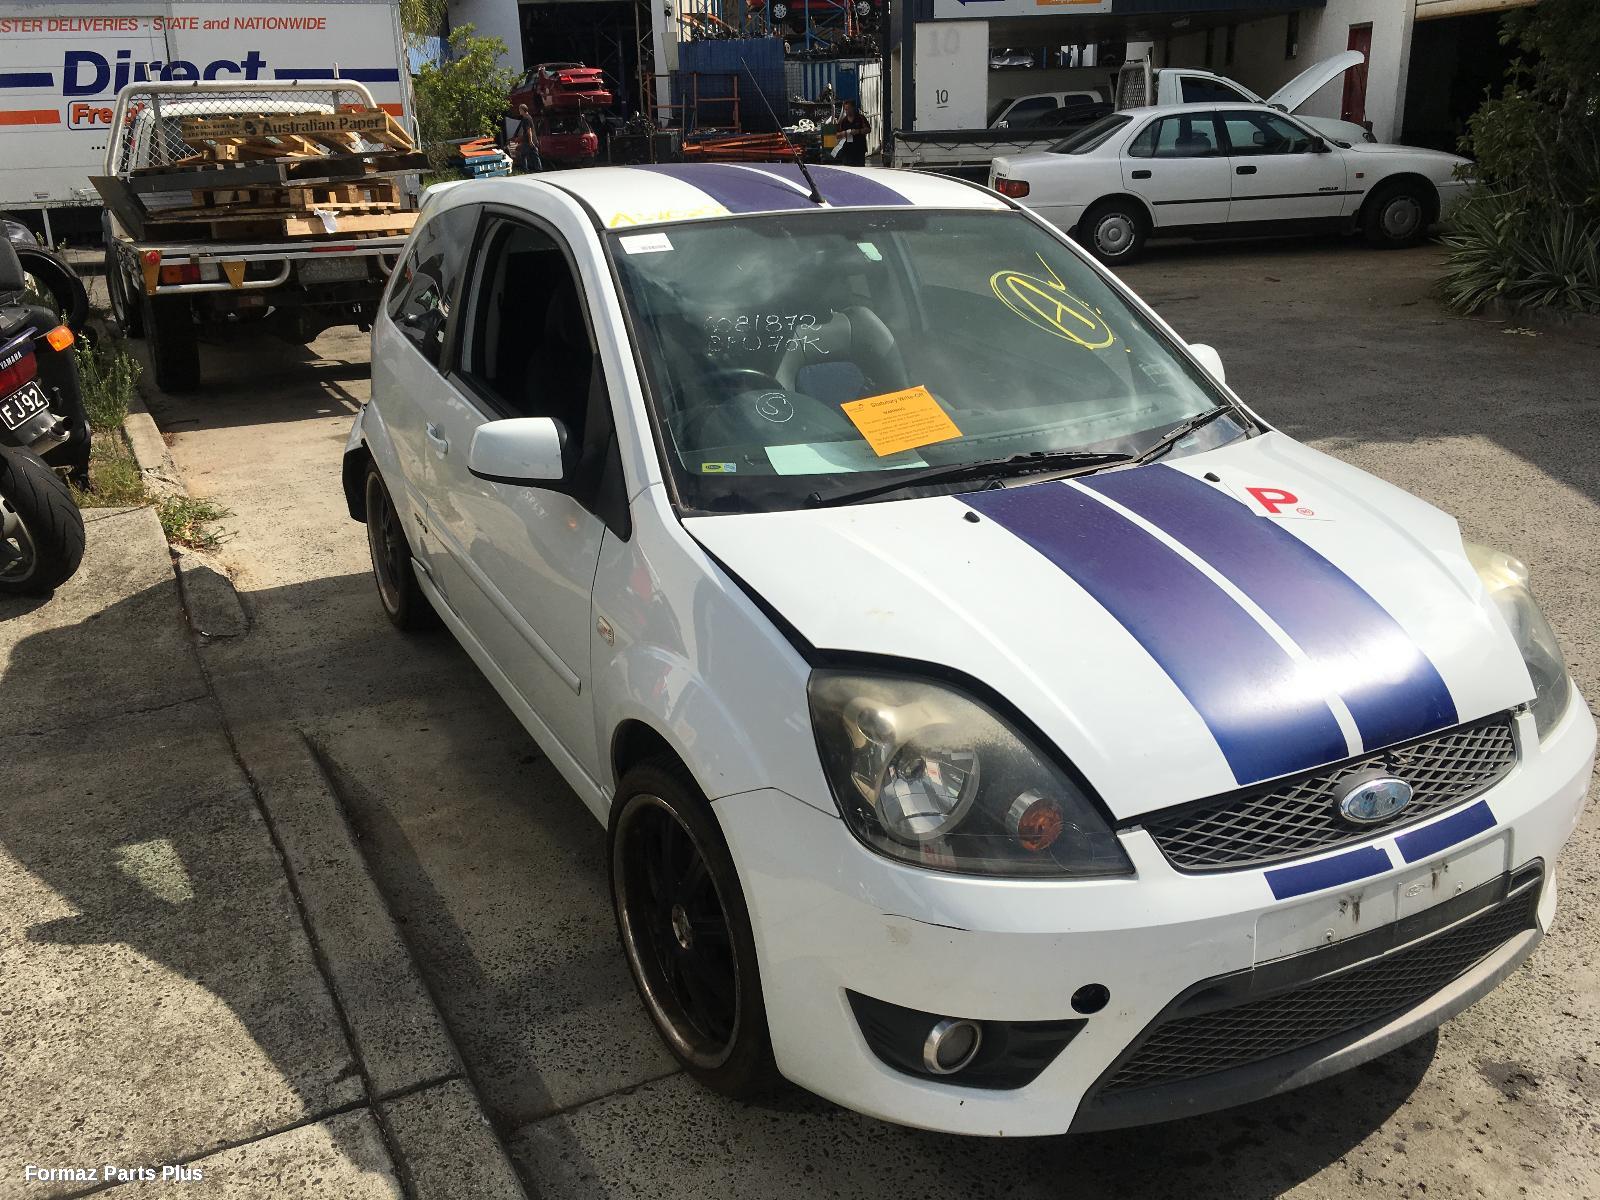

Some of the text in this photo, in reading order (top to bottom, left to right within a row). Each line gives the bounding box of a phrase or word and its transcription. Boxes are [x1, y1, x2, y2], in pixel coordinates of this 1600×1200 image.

[0, 17, 43, 33] STER
[48, 17, 138, 32] DELIVERIES
[153, 17, 199, 31] STATE
[203, 17, 230, 30] and
[234, 16, 327, 30] NATIONWIDE
[62, 49, 267, 97] Direct
[936, 88, 949, 105] 10
[262, 113, 381, 135] Australian Paper
[0, 350, 23, 370] YAMAHA
[1245, 487, 1298, 513] P
